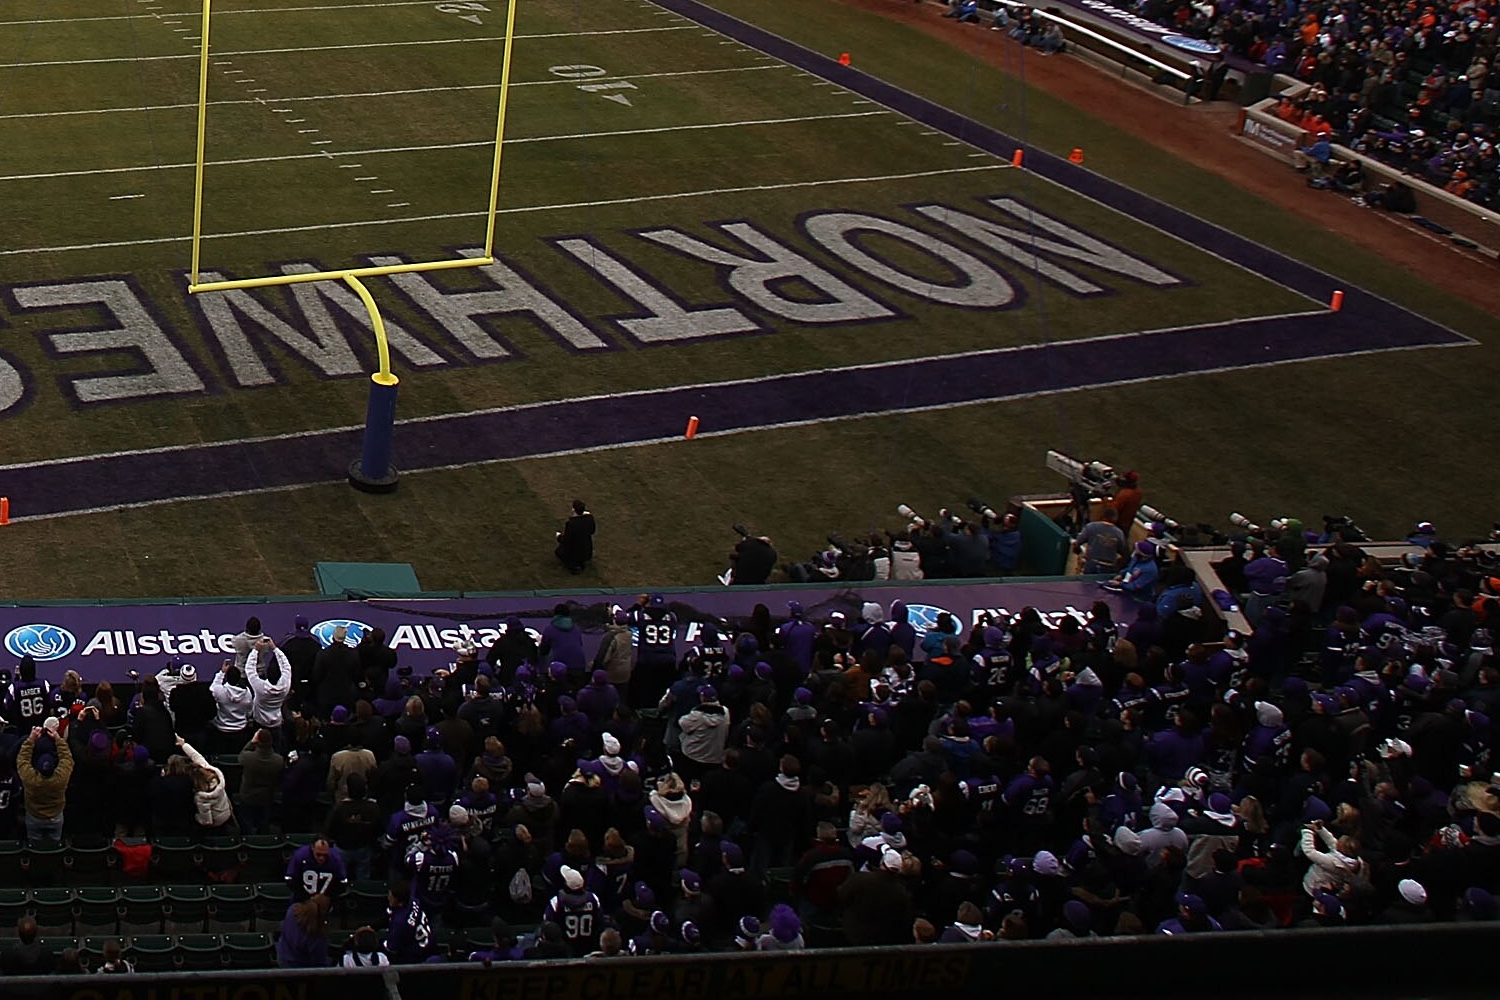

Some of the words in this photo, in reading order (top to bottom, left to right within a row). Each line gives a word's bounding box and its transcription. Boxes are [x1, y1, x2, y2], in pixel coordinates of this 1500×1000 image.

[548, 64, 639, 92] 10
[82, 629, 237, 657] Allstate
[644, 624, 670, 645] 93
[19, 697, 44, 717] 86
[1023, 796, 1050, 816] 68
[302, 869, 334, 895] 97
[565, 913, 594, 938] 90
